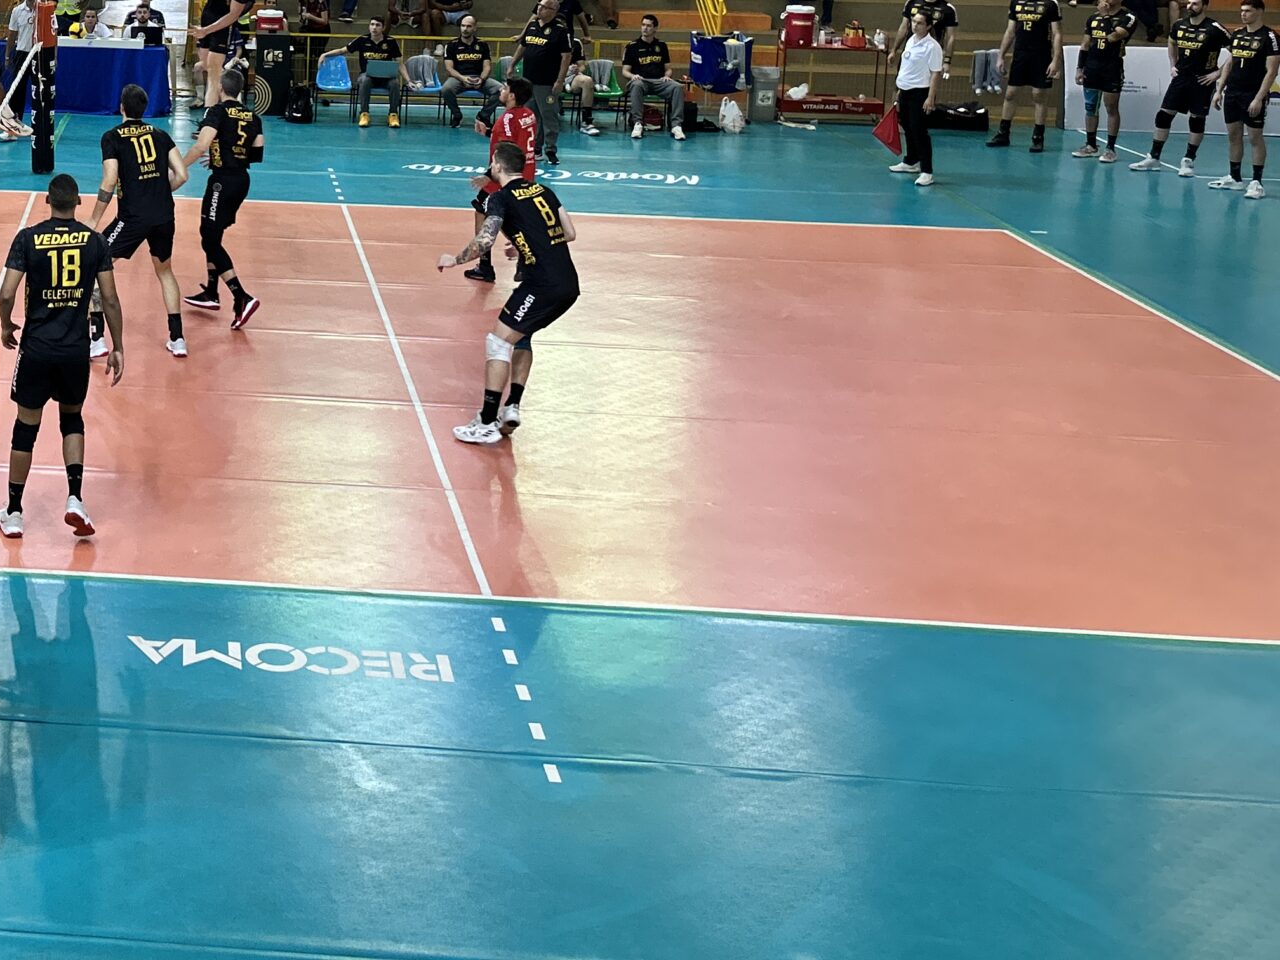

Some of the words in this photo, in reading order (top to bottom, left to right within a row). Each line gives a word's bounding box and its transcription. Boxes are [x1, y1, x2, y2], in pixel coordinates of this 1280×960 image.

[1023, 21, 1032, 31] 12
[117, 125, 154, 135] VEDACIT
[237, 120, 248, 145] 5
[527, 126, 535, 151] 2
[130, 133, 157, 164] 10
[577, 171, 700, 185] Monte
[532, 196, 556, 226] 8
[33, 231, 91, 245] VEDACIT
[47, 248, 81, 287] 18
[42, 288, 84, 300] CELESTINO
[127, 635, 455, 683] RECOMA
